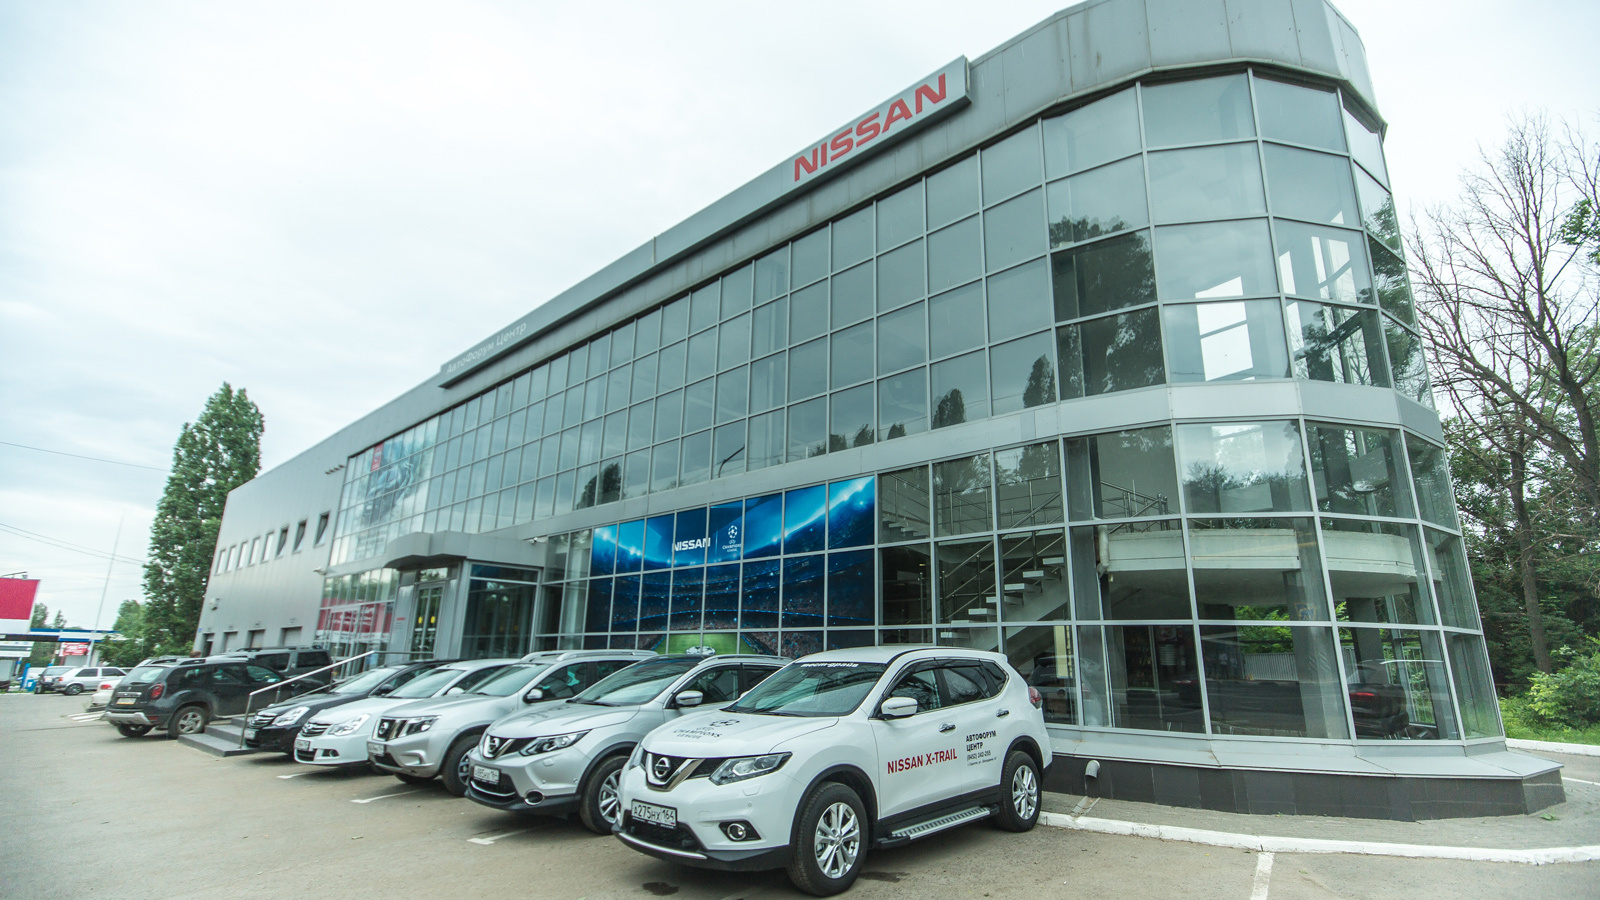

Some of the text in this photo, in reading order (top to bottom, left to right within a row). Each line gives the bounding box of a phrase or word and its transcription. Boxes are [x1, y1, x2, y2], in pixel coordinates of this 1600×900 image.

[794, 73, 946, 182] NISSAN
[496, 322, 527, 346] Центр
[672, 537, 711, 553] NISSAN
[965, 730, 997, 742] АВТОФОРУМ
[966, 742, 984, 752] ЦЕНТР
[887, 755, 923, 774] NISSAN
[925, 748, 958, 766] X-TRAIL
[661, 809, 675, 821] 164
